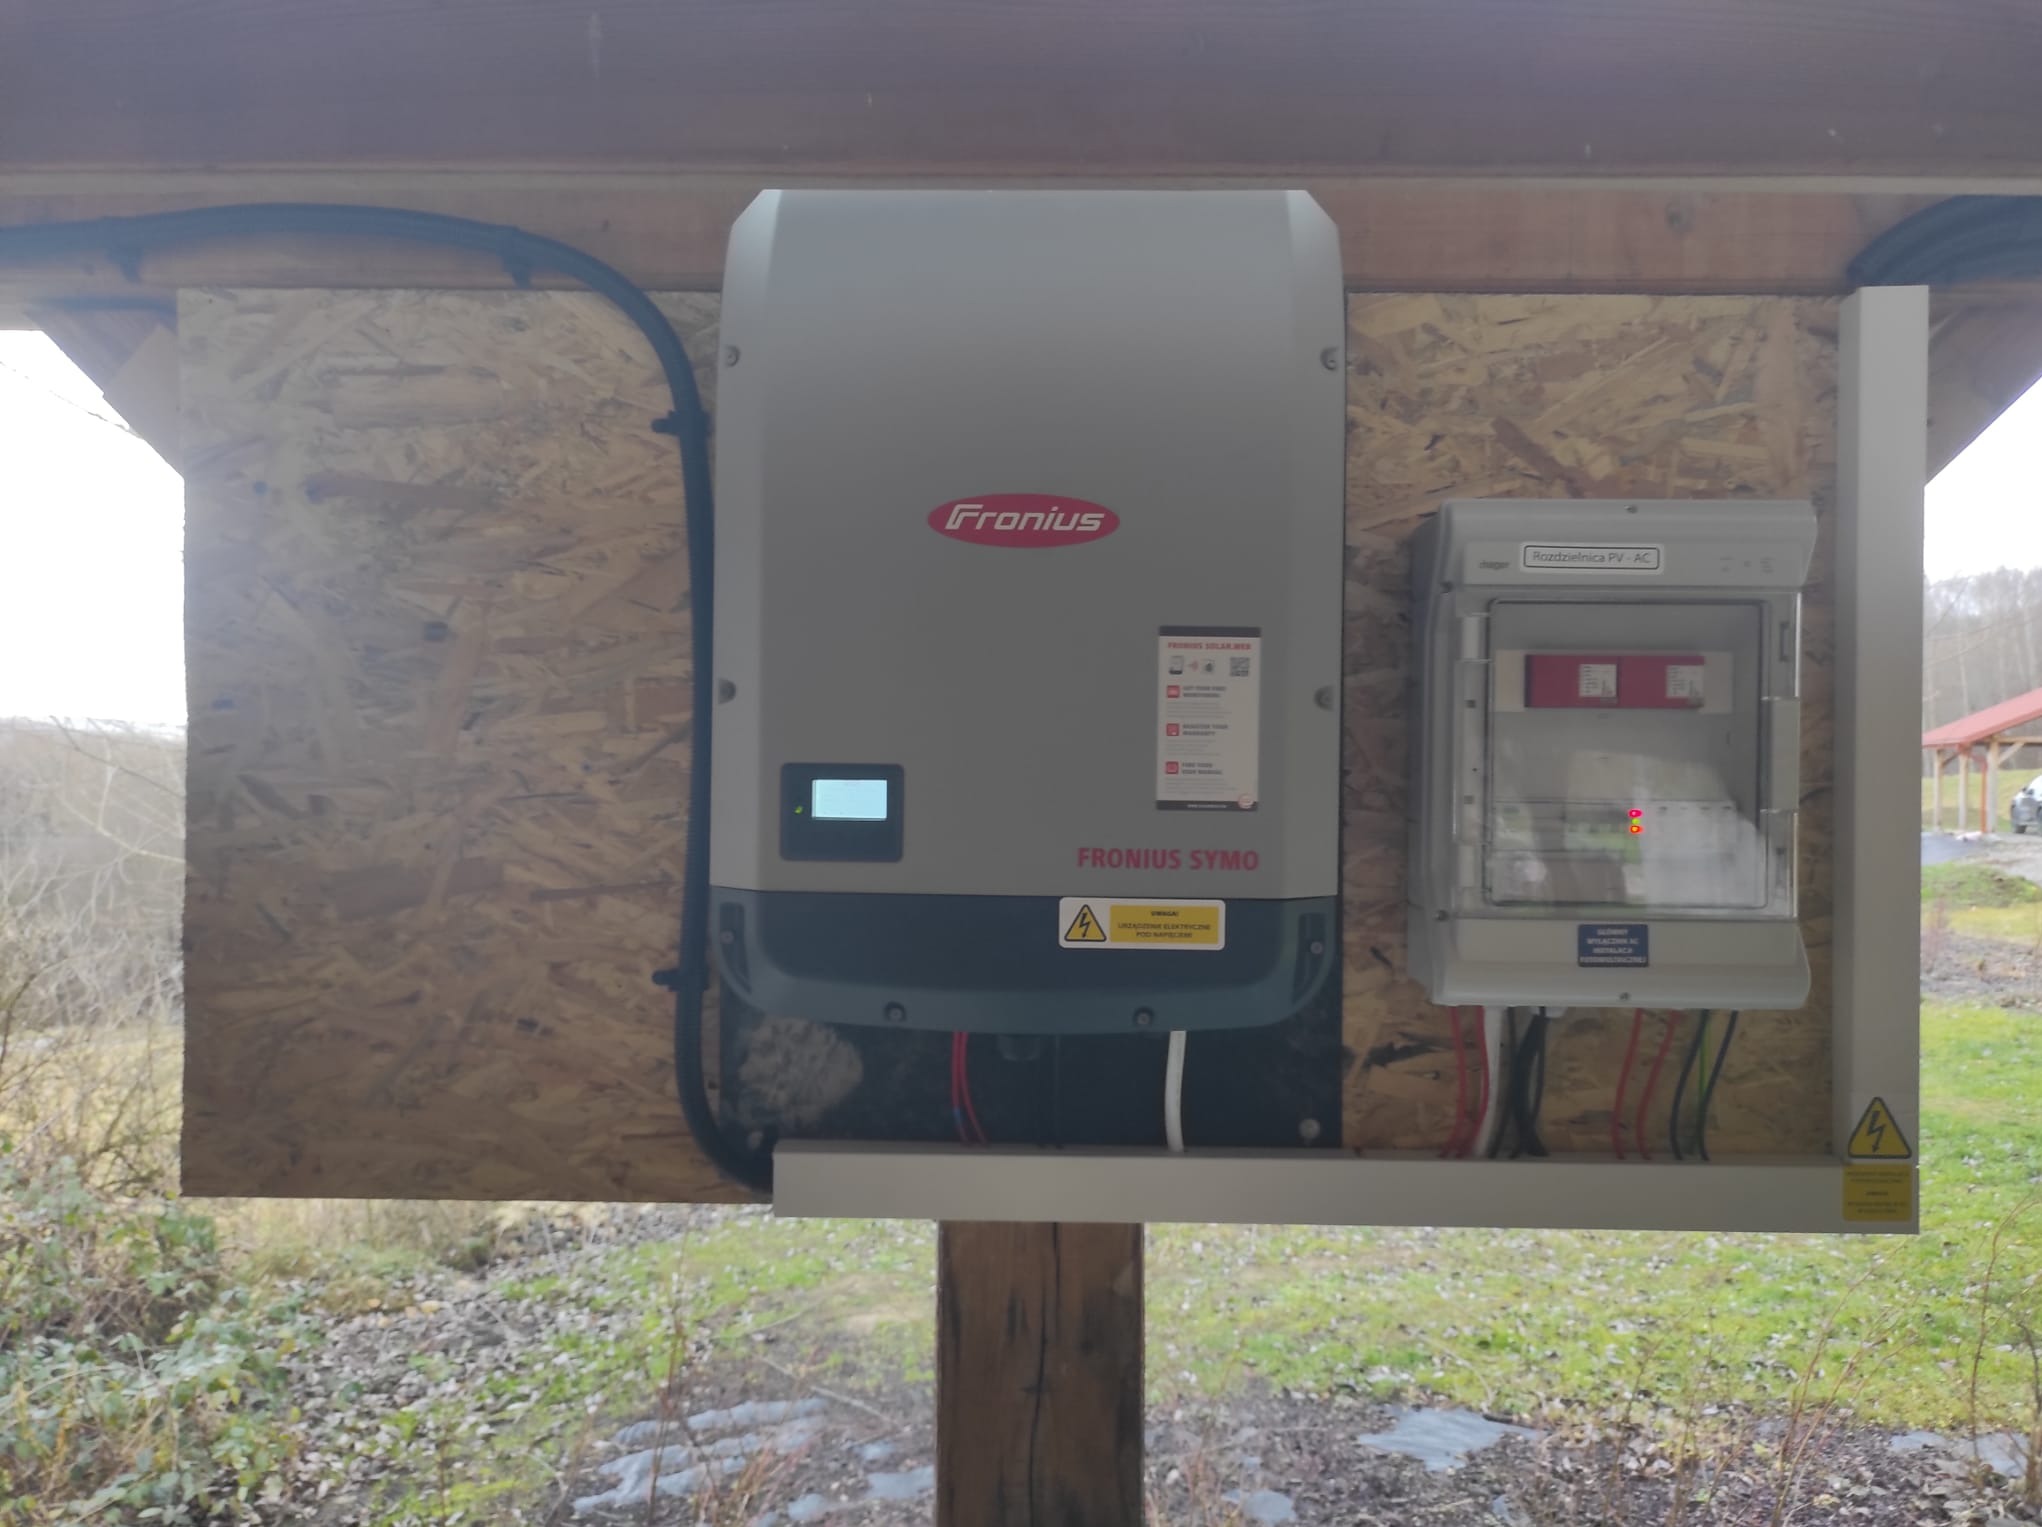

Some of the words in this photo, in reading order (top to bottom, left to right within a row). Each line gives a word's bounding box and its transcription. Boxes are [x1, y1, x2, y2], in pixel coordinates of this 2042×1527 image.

[944, 503, 1105, 531] Fronius
[1533, 551, 1604, 562] Rozdzielnica
[1608, 552, 1624, 562] PV
[1633, 552, 1650, 563] AC
[1077, 847, 1182, 870] FRONIUS
[1189, 849, 1259, 871] SYMO
